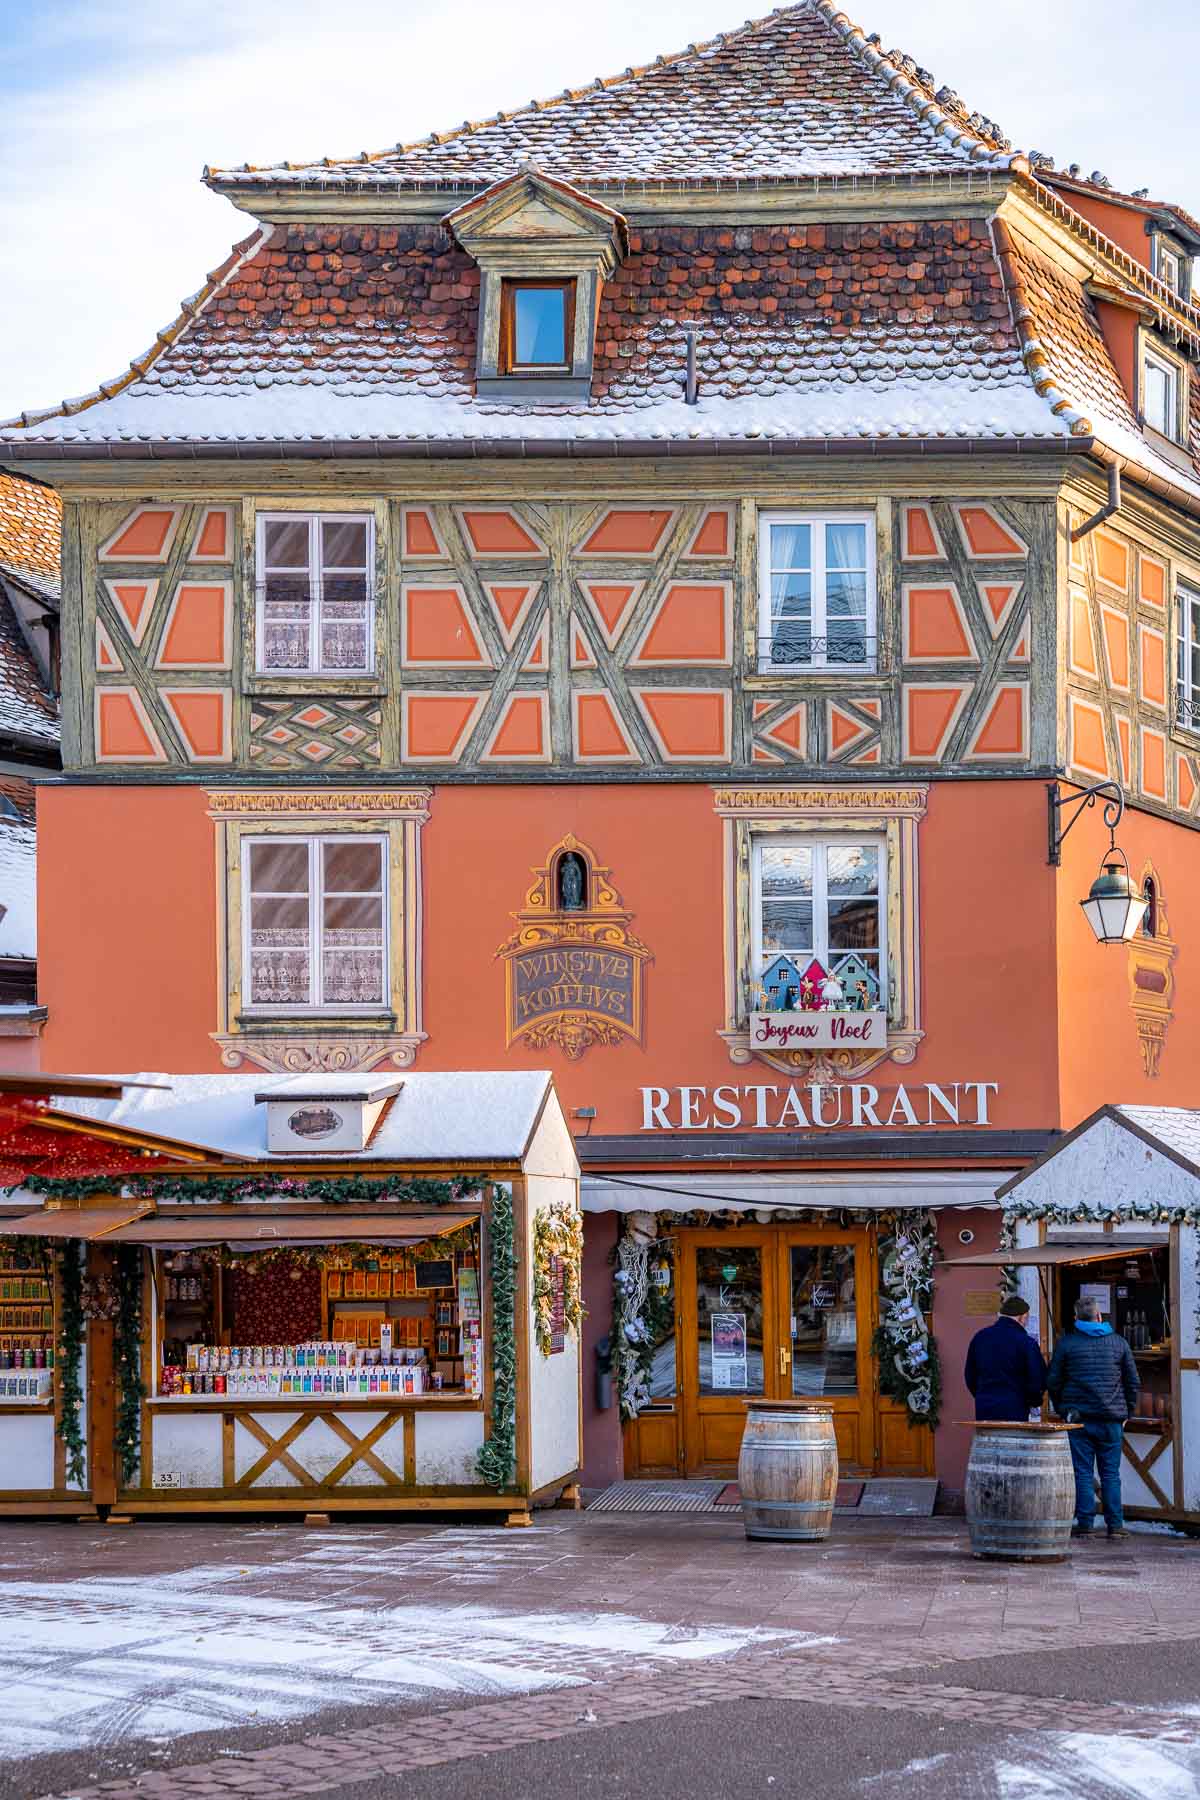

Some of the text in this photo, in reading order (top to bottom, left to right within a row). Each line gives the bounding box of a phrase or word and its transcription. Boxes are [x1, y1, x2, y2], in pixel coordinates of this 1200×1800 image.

[755, 1017, 819, 1046] Joyeux
[638, 1083, 998, 1129] RESTAURANT
[160, 1474, 172, 1482] 33
